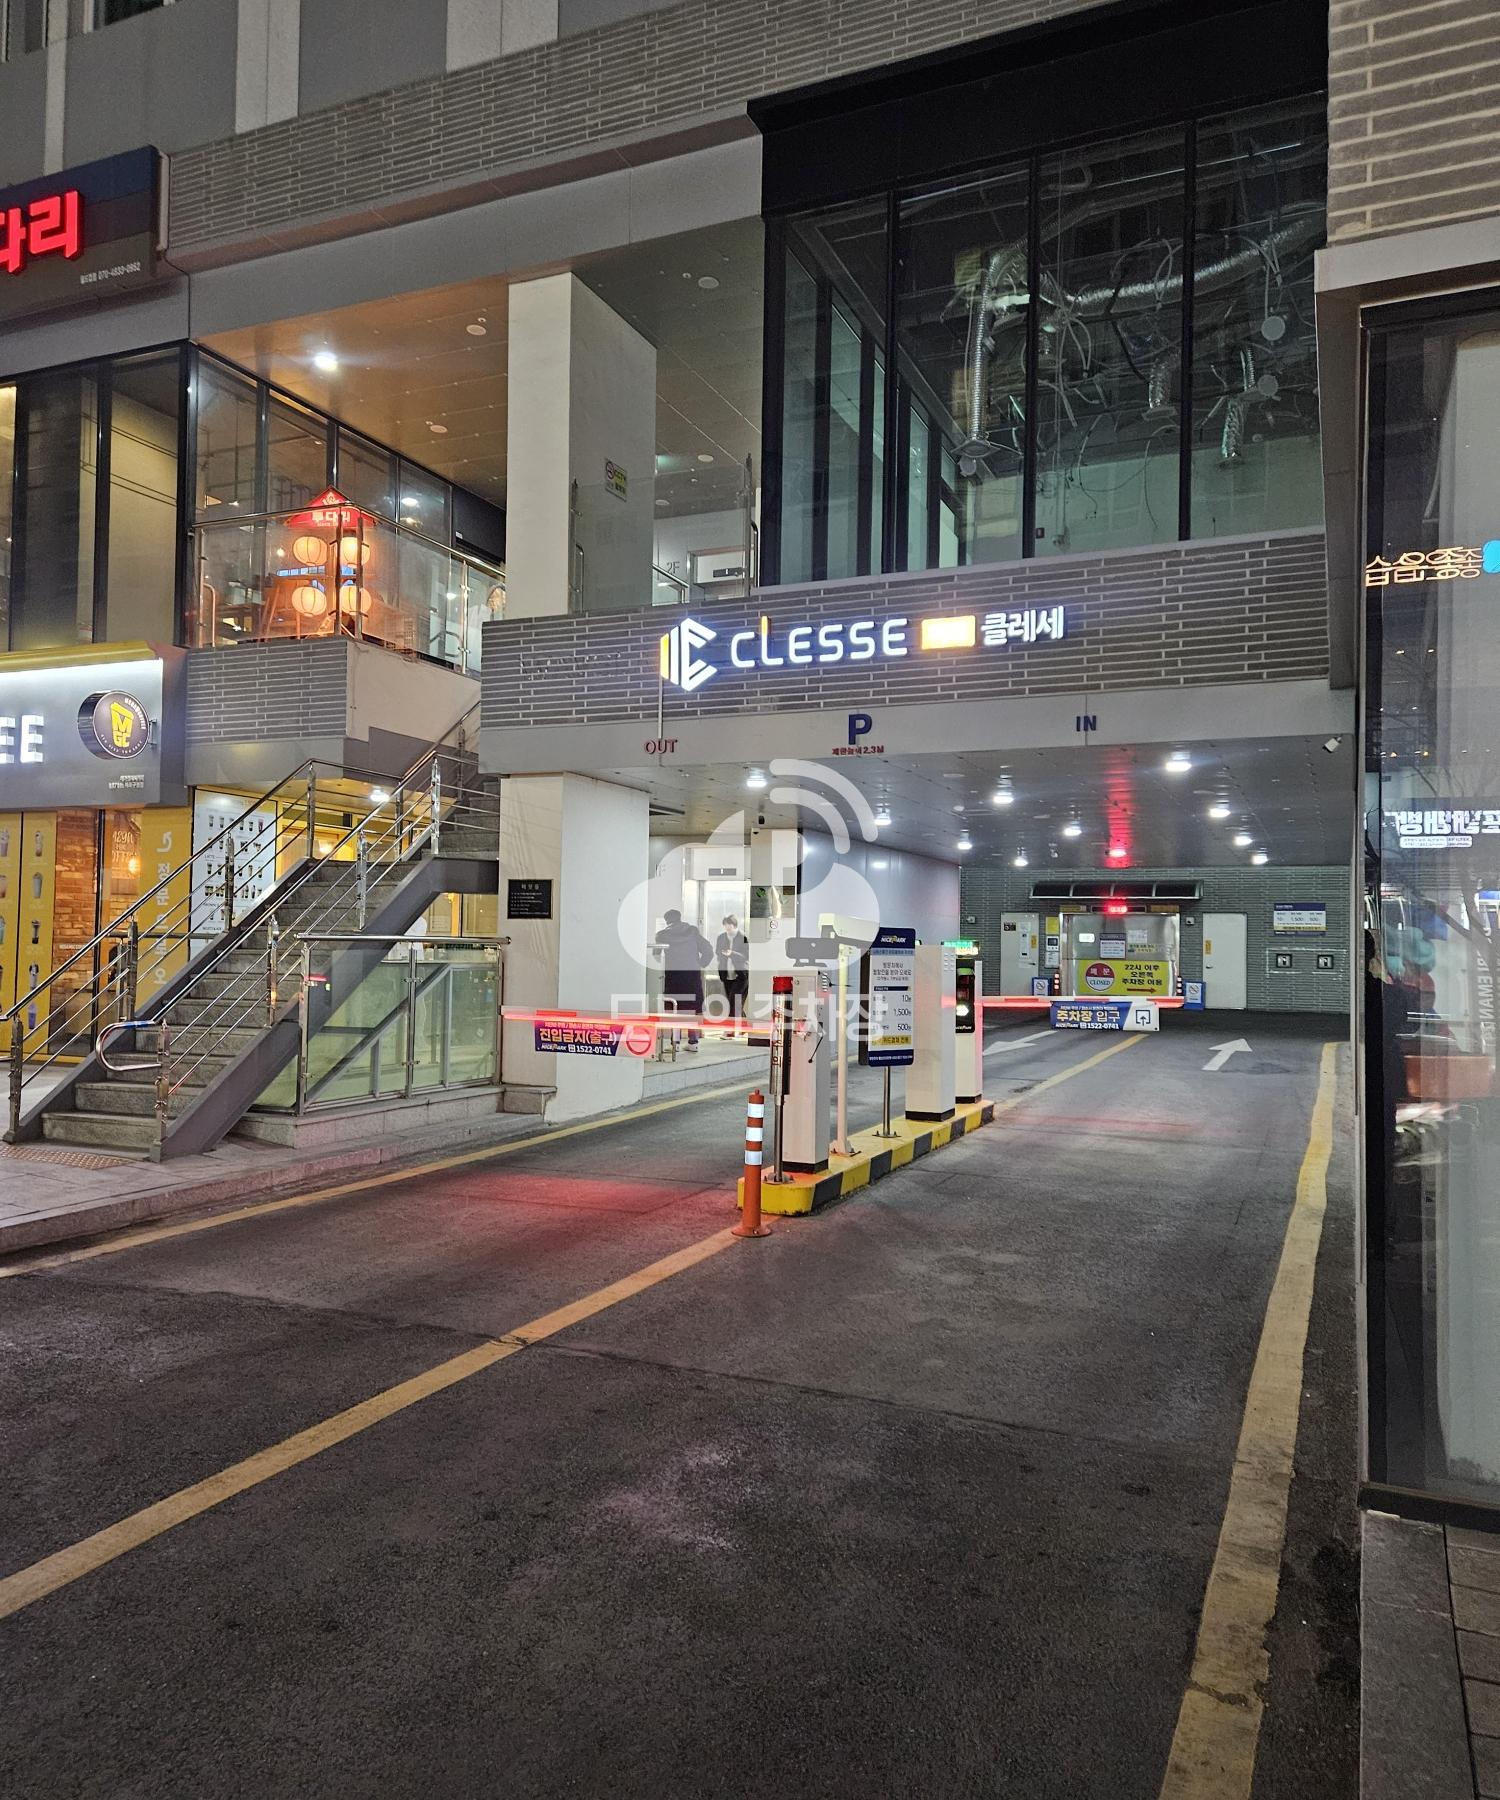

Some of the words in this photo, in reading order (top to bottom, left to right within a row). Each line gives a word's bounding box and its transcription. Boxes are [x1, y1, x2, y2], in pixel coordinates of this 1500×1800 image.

[981, 605, 1065, 646] 클레세
[731, 616, 908, 668] CLESSE
[848, 713, 873, 746] P
[1076, 715, 1097, 732] IN
[645, 738, 679, 755] OUT
[1056, 1010, 1092, 1022] 주차장
[1096, 1010, 1120, 1023] 입구
[540, 1028, 617, 1046] 진입금지(출구)
[576, 1044, 612, 1055] 1522-0741
